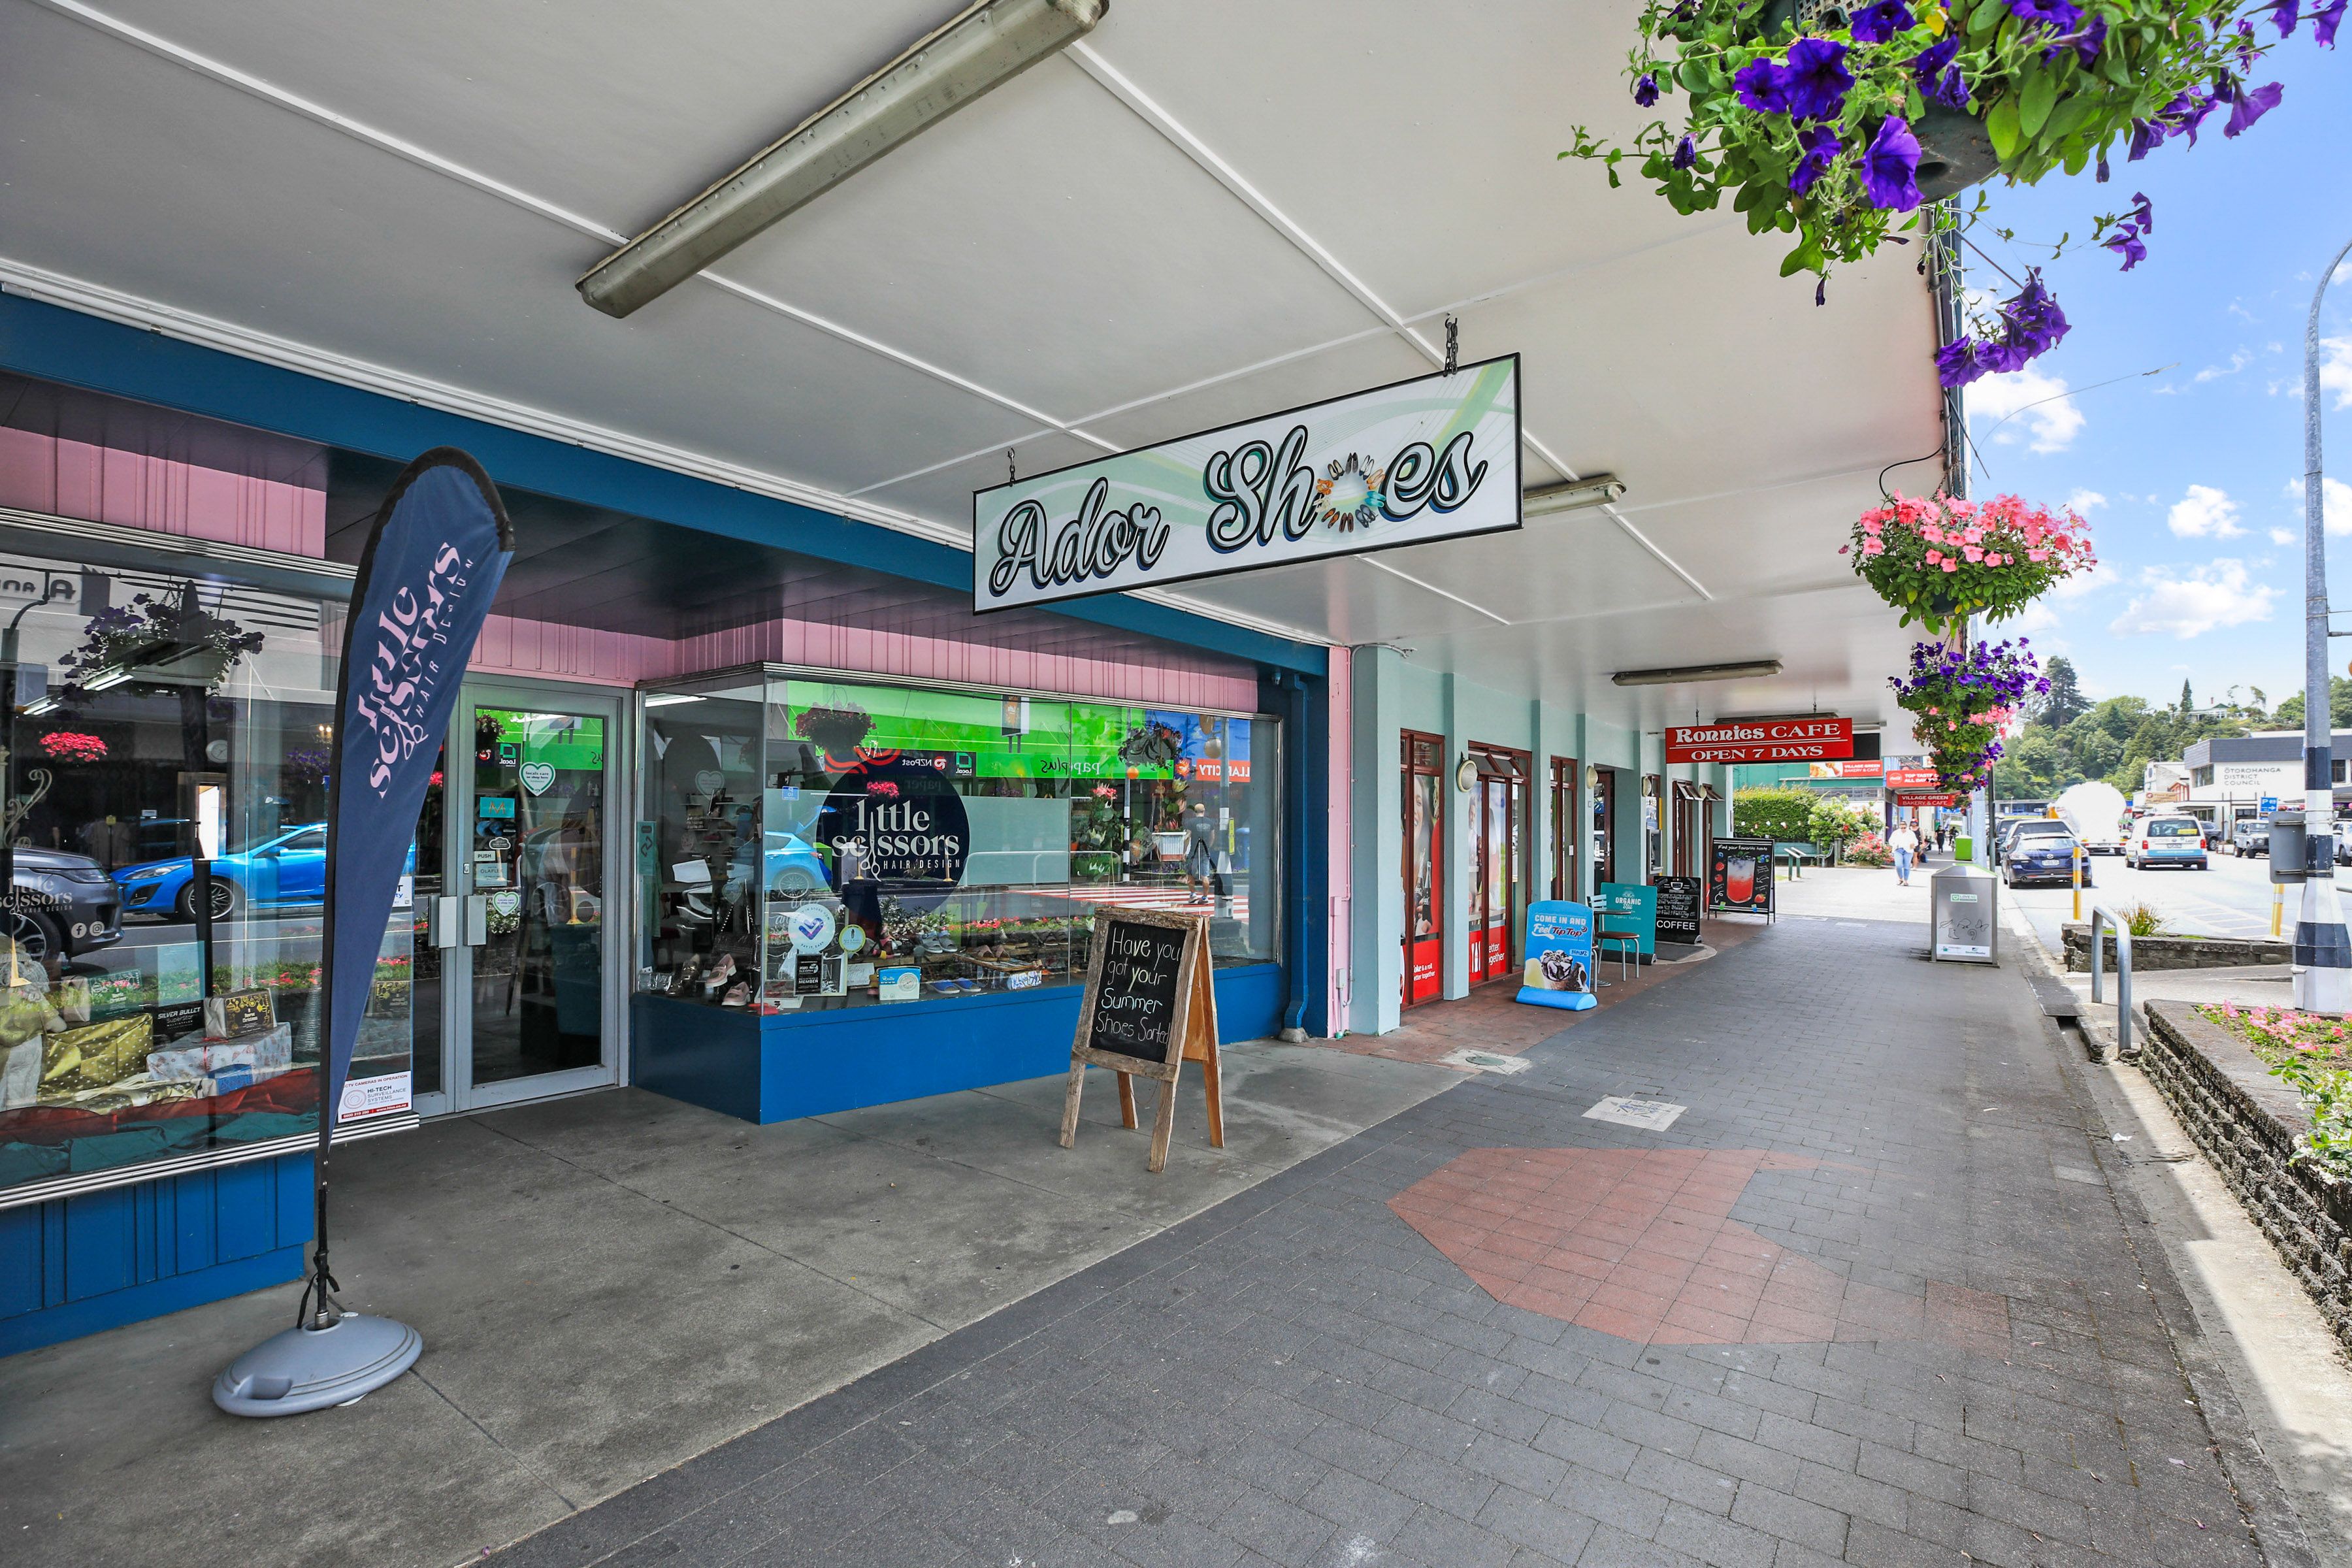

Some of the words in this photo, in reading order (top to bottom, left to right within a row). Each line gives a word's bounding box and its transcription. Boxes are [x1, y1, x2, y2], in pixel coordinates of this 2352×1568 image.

[988, 476, 1170, 597] Ador
[1202, 424, 1489, 555] Shoes
[416, 662, 439, 718] HAIR
[1675, 725, 1765, 743] Ronnies
[1771, 723, 1841, 738] CAFE
[1691, 749, 1746, 760] OPEN
[1752, 749, 1765, 759] 7
[1771, 745, 1823, 758] DAYS
[855, 799, 930, 832] little
[832, 834, 960, 858] scissors
[883, 860, 910, 870] HAIR
[919, 859, 960, 869] DESIGN
[1615, 897, 1641, 906] ORGANIC
[1535, 915, 1556, 923] COME
[1656, 920, 1695, 930] COFFEE
[1552, 926, 1565, 936] Tip
[1566, 928, 1582, 938] Top
[1111, 927, 1151, 957] Have
[1156, 941, 1181, 971] you
[1488, 943, 1499, 953] etter
[1488, 953, 1505, 966] gether
[1107, 958, 1128, 985] got
[1128, 966, 1168, 992] your
[1101, 988, 1163, 1014] Summer
[157, 1011, 178, 1020] SILVER
[179, 1007, 201, 1016] BULLET
[1096, 1011, 1134, 1037] Shoes
[1137, 1017, 1171, 1045] Sorted
[367, 1088, 406, 1098] SURVEILLANCE
